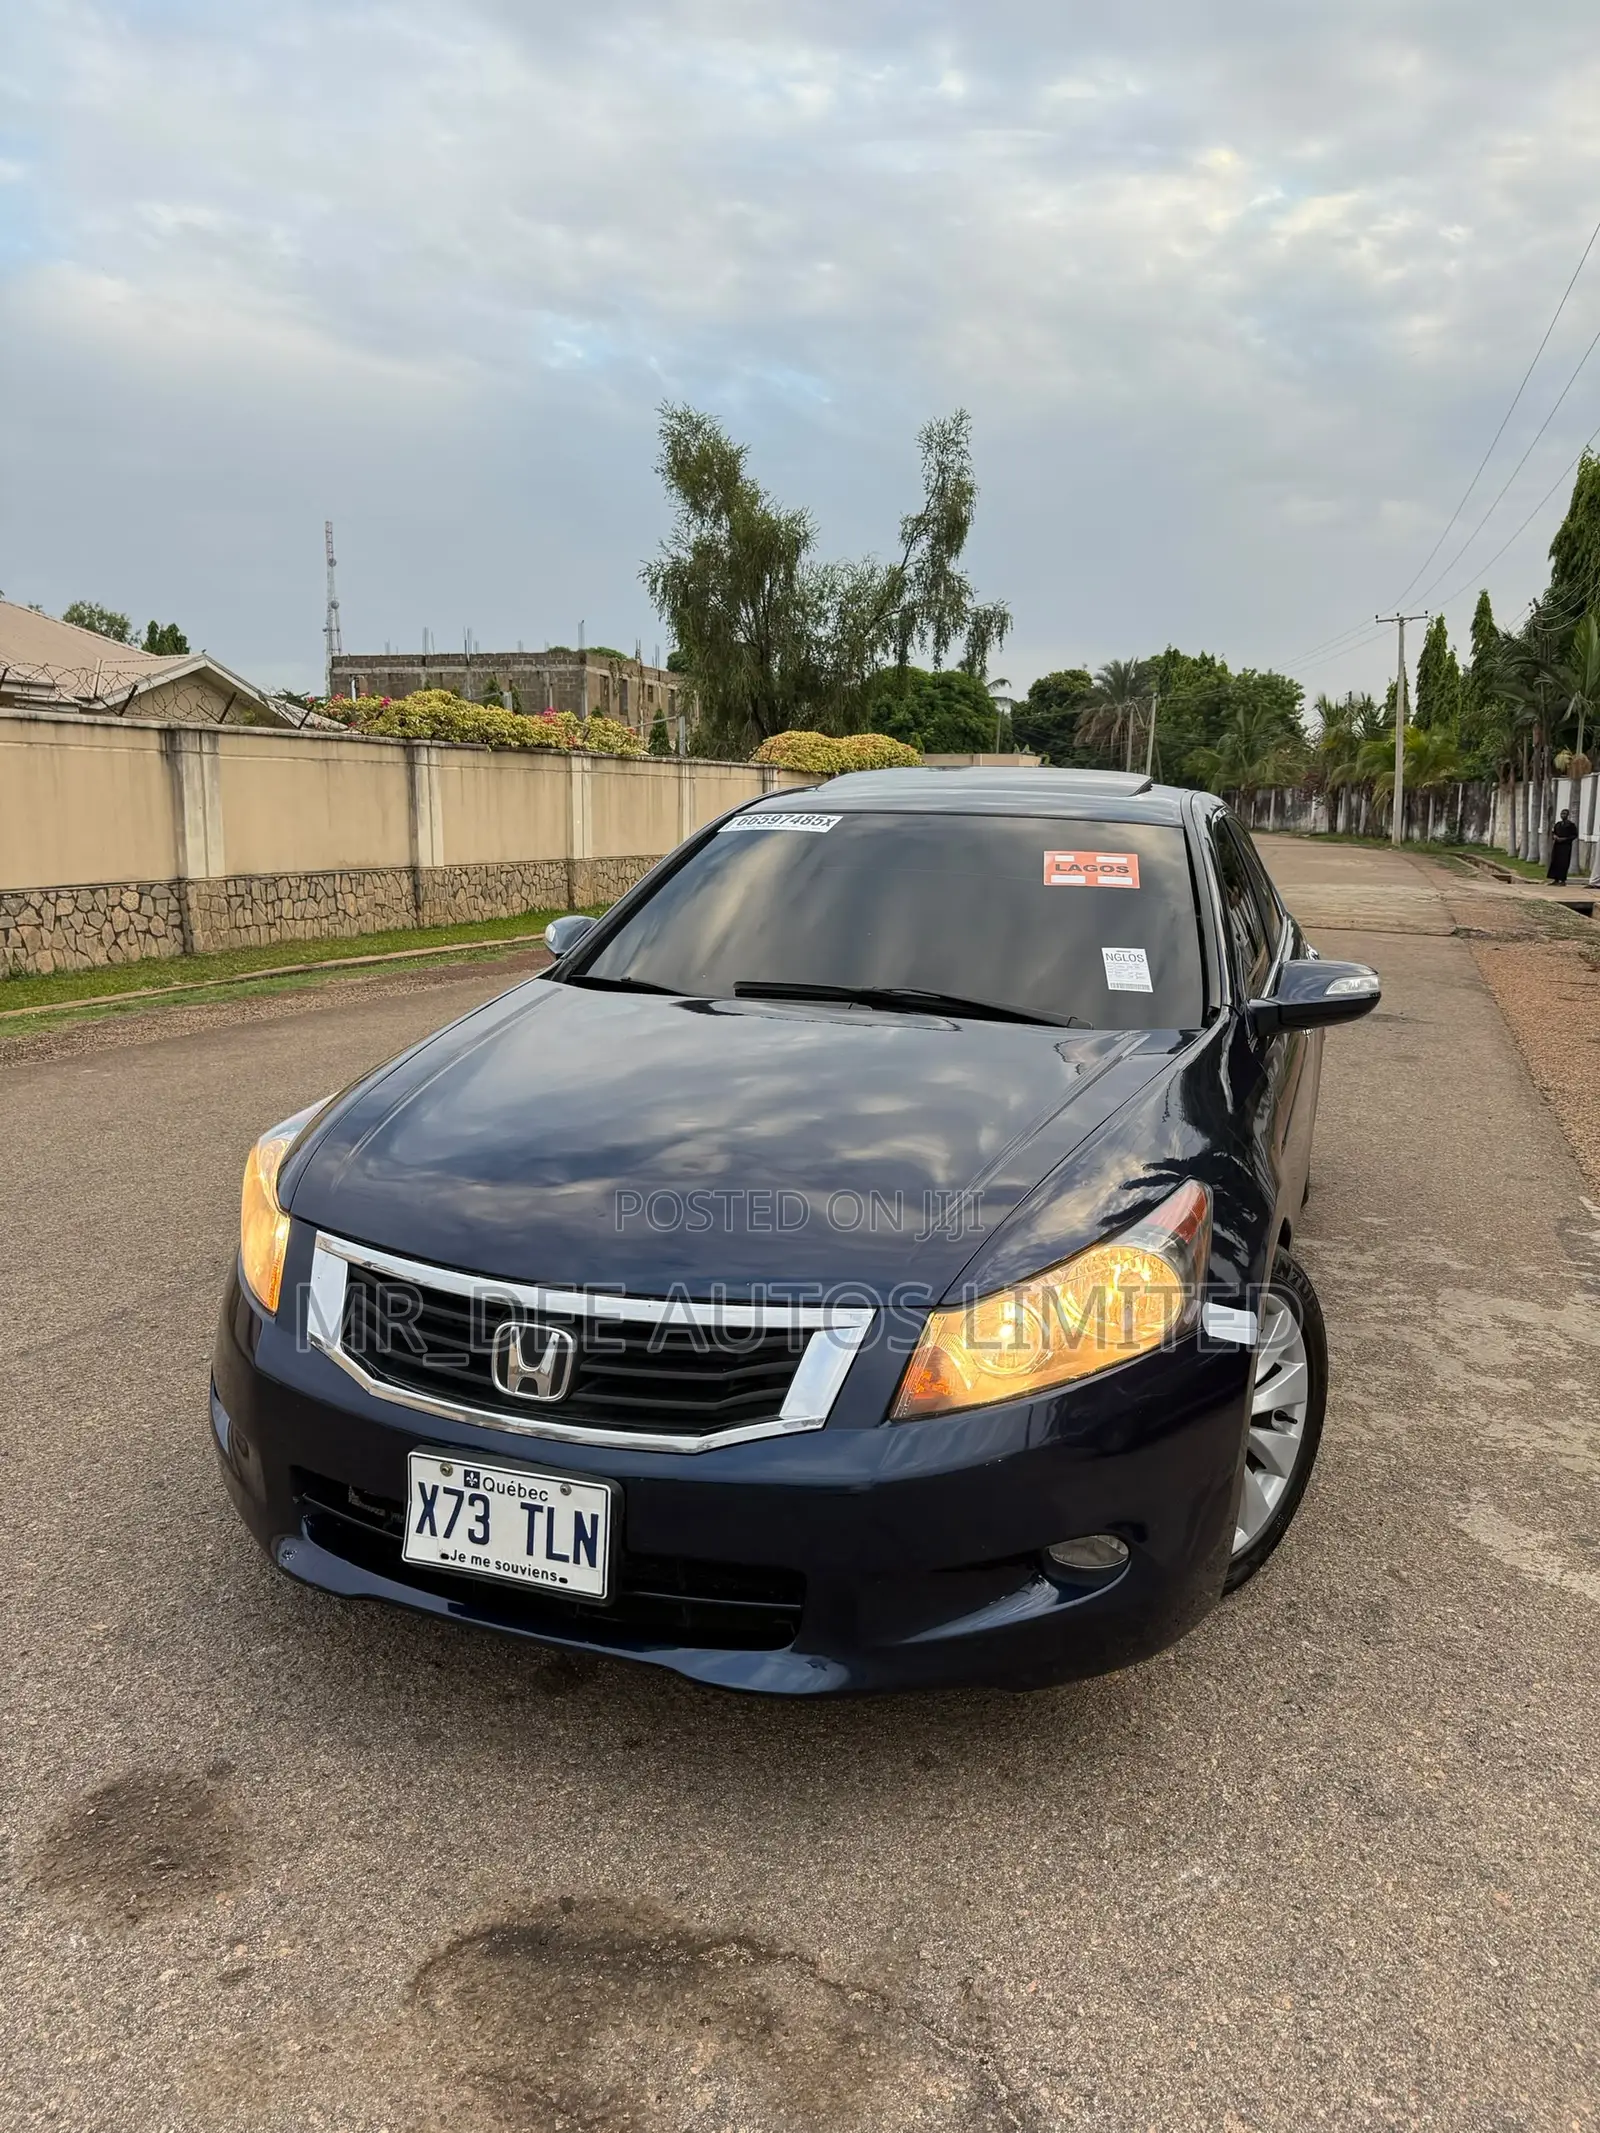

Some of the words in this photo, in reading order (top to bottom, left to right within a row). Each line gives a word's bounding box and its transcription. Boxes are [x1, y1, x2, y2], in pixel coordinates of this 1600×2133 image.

[1055, 863, 1130, 874] LAGOS
[1105, 952, 1145, 963] NGLOS
[482, 1476, 549, 1502] Québec
[415, 1481, 491, 1546] X73
[520, 1501, 600, 1569] TLN
[450, 1549, 467, 1563] Je
[471, 1555, 491, 1568] me
[494, 1559, 558, 1583] souviens
